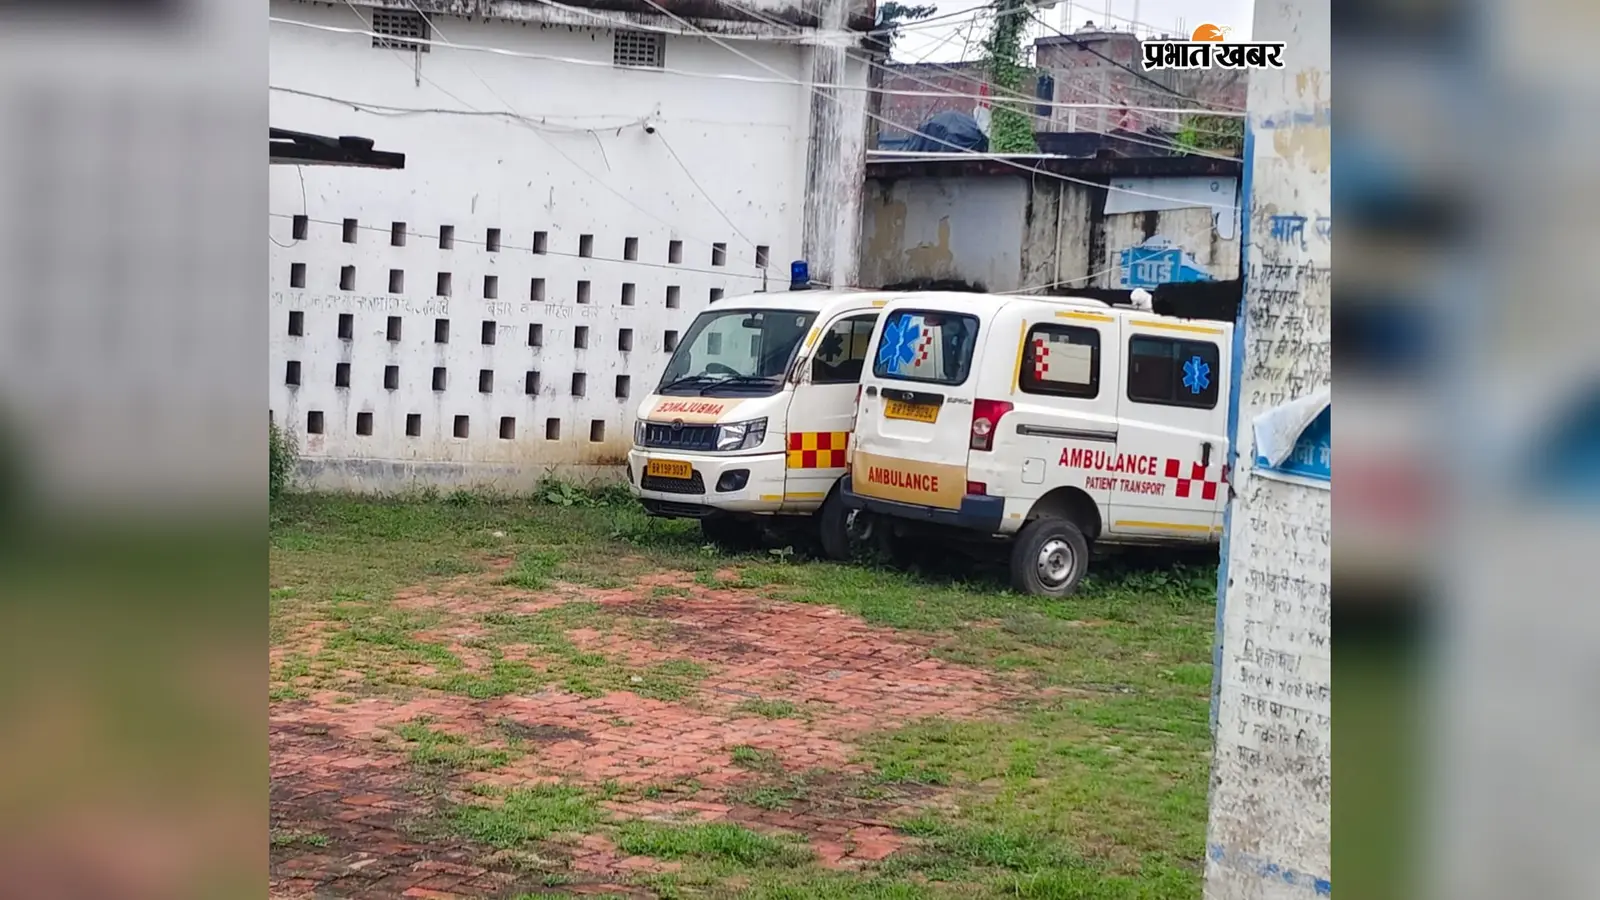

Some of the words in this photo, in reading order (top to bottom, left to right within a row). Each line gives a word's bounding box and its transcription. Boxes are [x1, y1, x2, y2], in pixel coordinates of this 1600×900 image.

[1058, 447, 1158, 476] AMBULANCE
[868, 466, 939, 492] AMBULANCE
[1085, 476, 1117, 491] PATIENT
[1120, 478, 1166, 496] TRANSPORT
